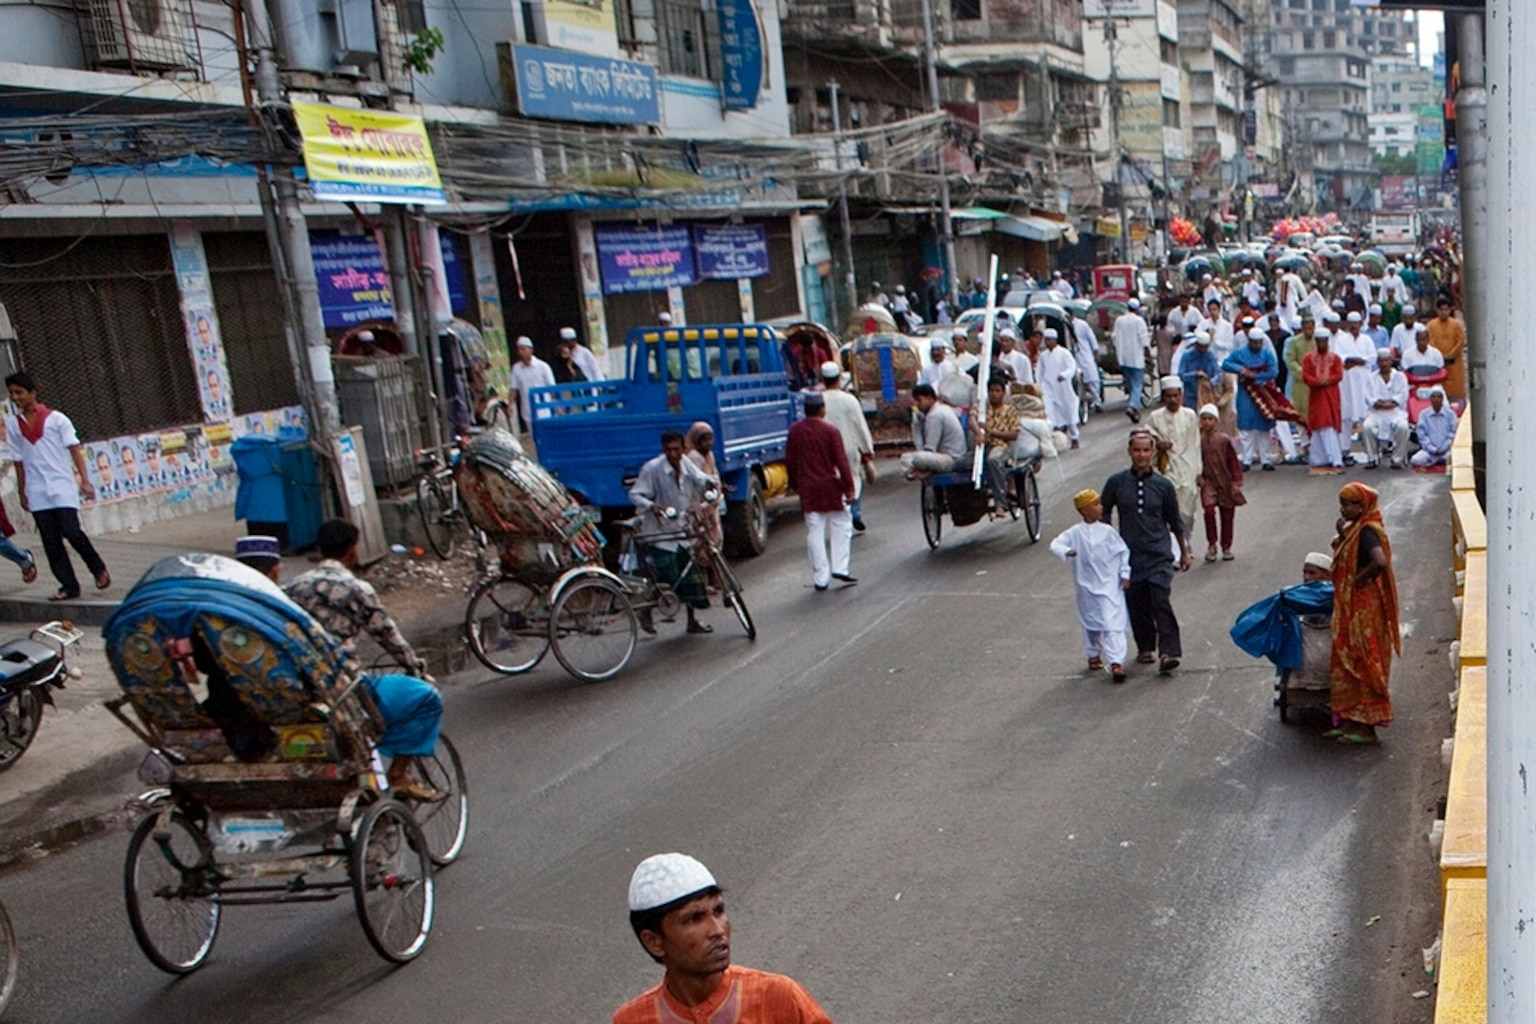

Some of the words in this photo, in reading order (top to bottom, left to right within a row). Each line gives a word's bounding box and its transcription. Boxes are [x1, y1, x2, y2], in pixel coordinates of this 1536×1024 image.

[543, 61, 579, 95] জনতা
[579, 66, 610, 98] ব্যাংক
[609, 62, 652, 100] লিমিটেড
[326, 114, 361, 152] ঈদ
